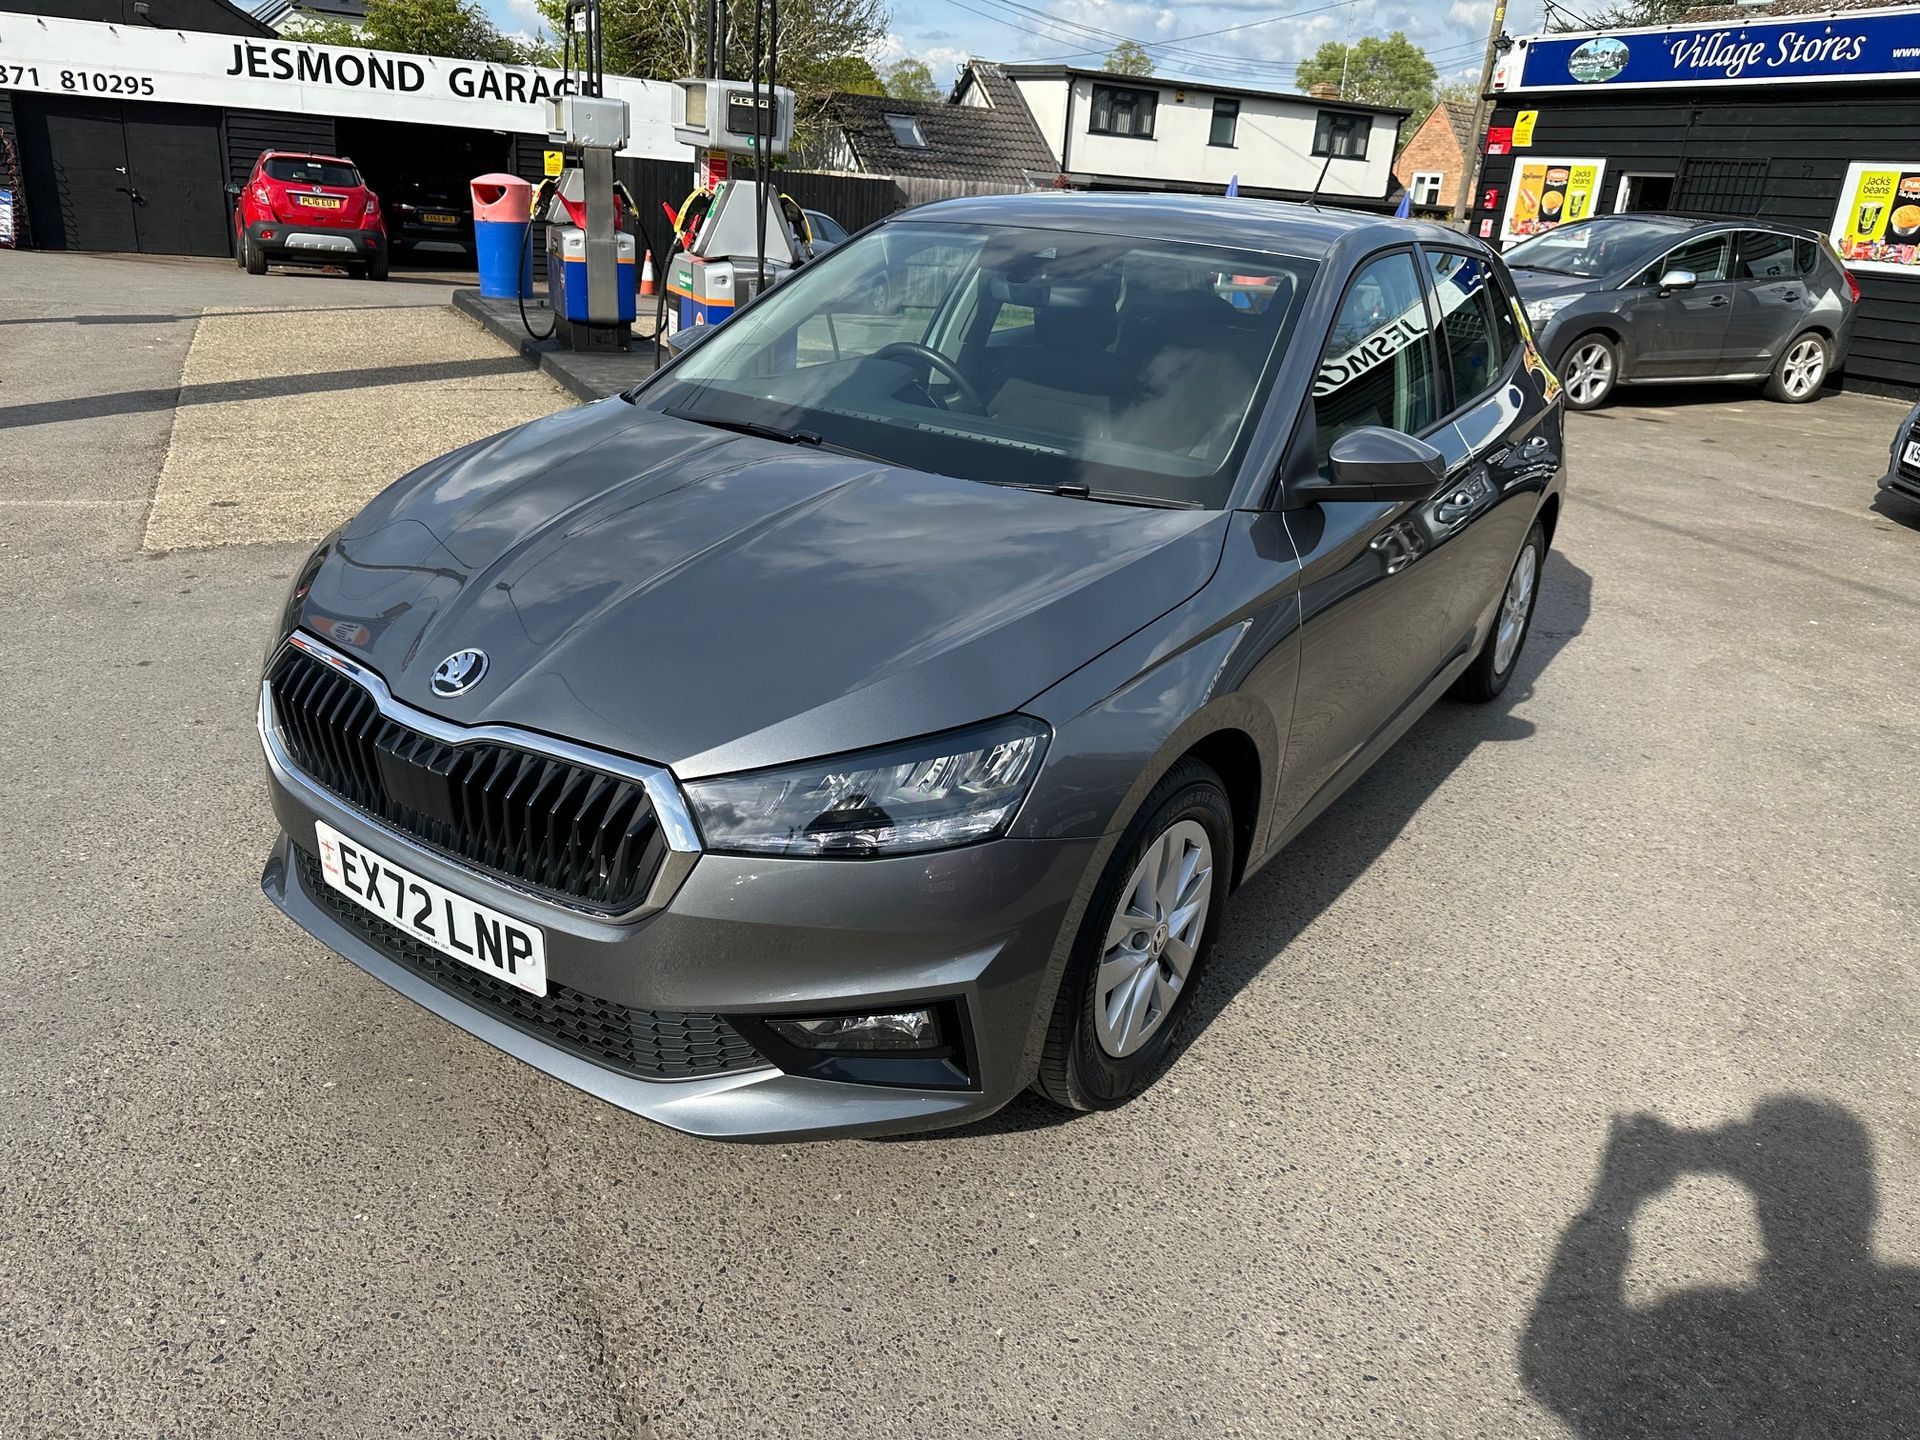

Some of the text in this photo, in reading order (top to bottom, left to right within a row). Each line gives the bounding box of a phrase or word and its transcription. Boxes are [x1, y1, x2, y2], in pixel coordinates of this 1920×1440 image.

[1670, 31, 1867, 77] Village Stores
[227, 44, 424, 92] JESMOND
[60, 70, 154, 95] 810295
[1863, 185, 1890, 195] beans
[1866, 176, 1892, 186] Jack's
[302, 197, 320, 207] PL16
[338, 841, 533, 975] EX72 LNP
